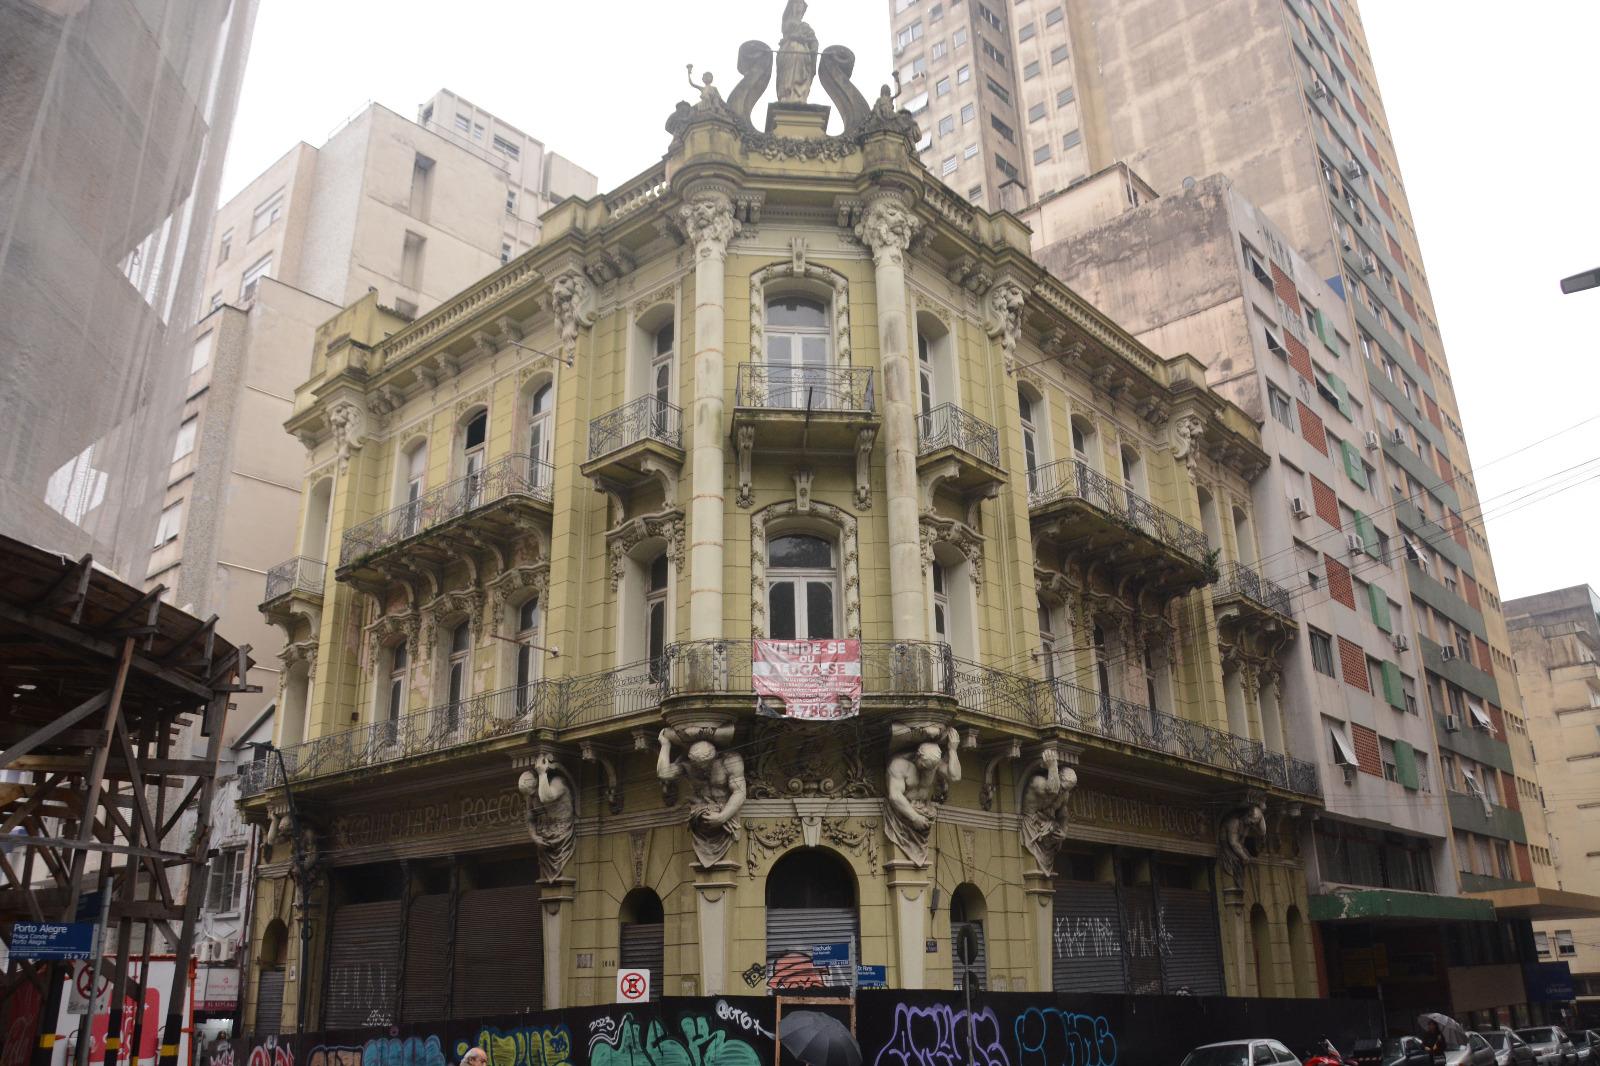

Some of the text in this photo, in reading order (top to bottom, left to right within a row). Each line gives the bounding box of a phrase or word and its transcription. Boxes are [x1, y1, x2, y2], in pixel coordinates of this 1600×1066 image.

[770, 642, 846, 655] VENDE-SE
[799, 655, 815, 663] OU
[459, 792, 521, 831] ROCCO
[13, 923, 67, 934] Porto Alegre
[588, 1016, 616, 1032] 2023
